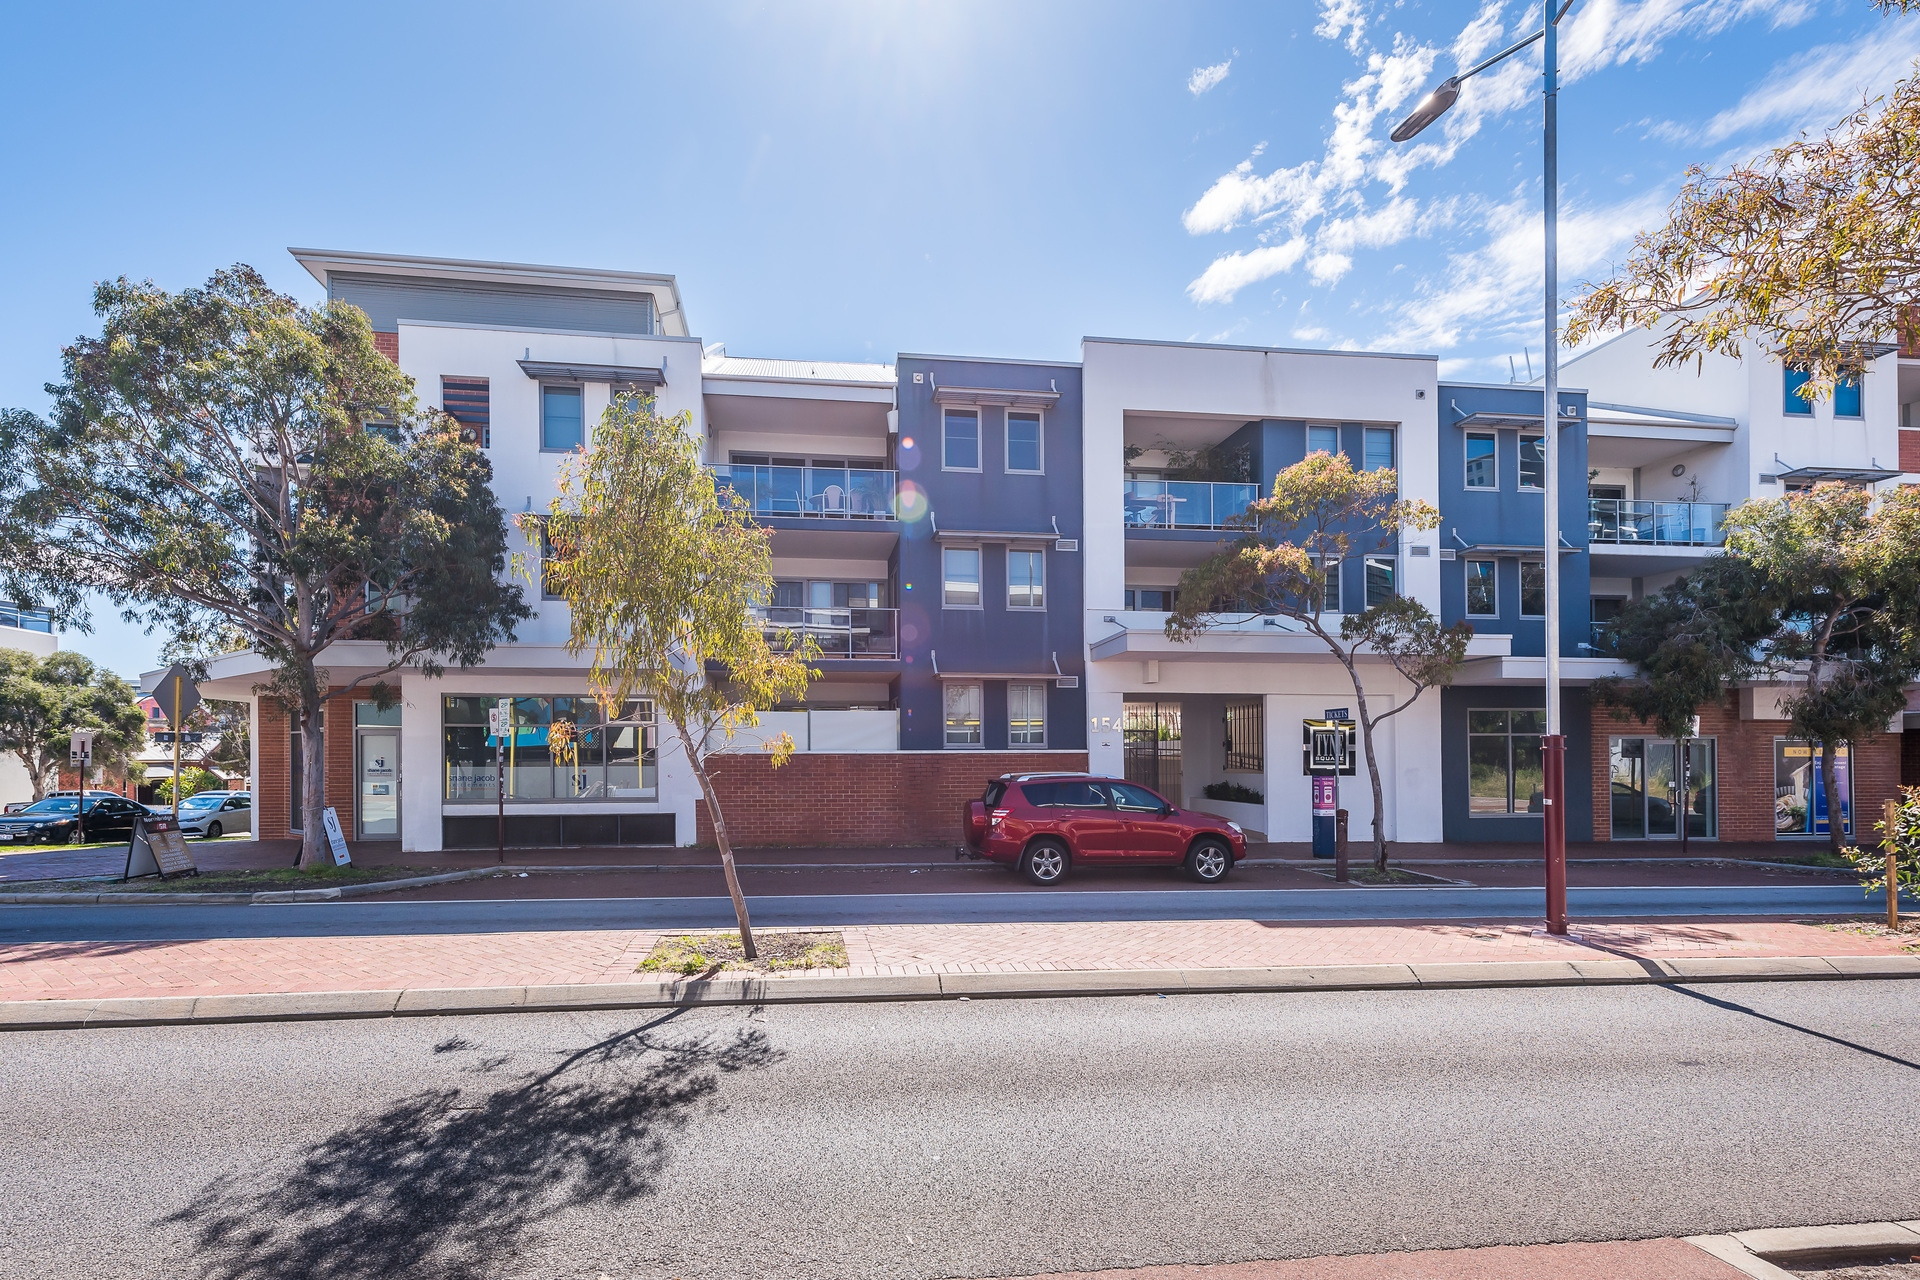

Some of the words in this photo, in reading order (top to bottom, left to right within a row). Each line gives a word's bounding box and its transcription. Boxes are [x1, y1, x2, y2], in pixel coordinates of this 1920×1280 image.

[1326, 710, 1348, 719] TICKETS
[1090, 717, 1122, 732] 154
[473, 774, 495, 783] jacob
